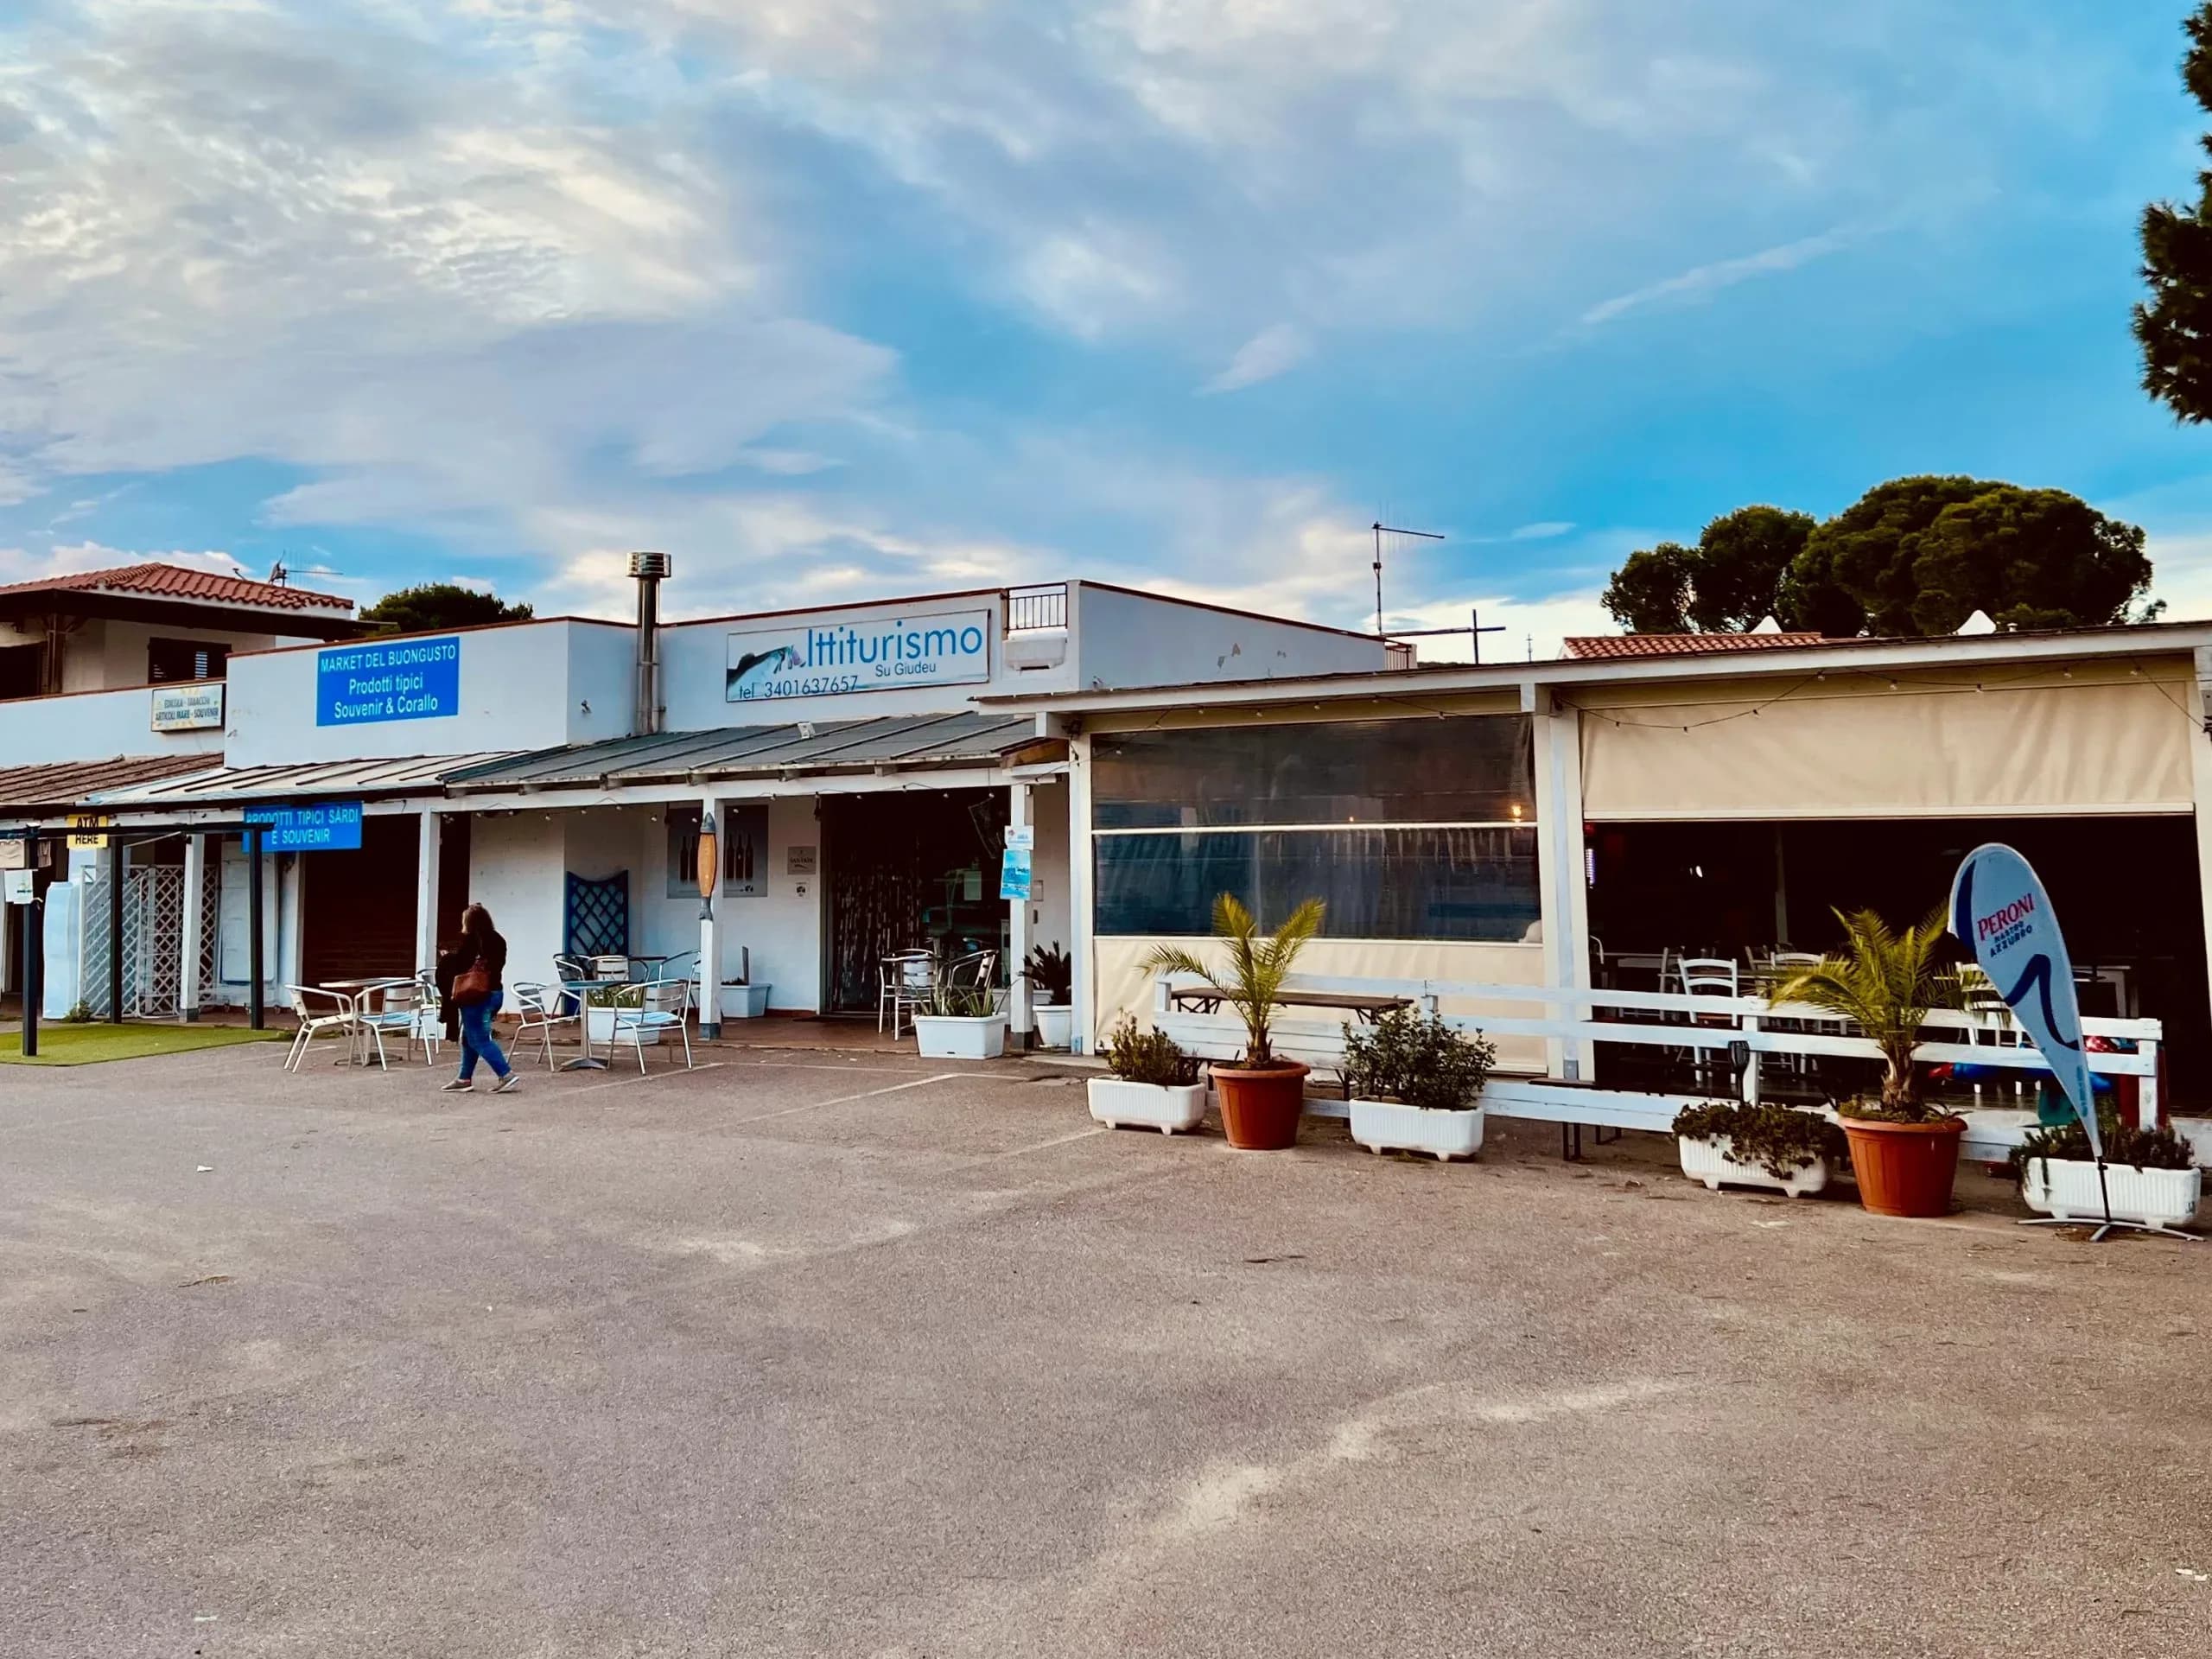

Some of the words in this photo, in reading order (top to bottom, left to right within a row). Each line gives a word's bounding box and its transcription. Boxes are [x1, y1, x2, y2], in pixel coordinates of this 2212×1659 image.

[808, 620, 982, 666] Ittiturismo
[321, 654, 363, 672] MARKET
[365, 652, 385, 668] DEL
[389, 645, 456, 664] BUONGUSTO
[875, 664, 891, 677] Su
[894, 662, 937, 676] Giudeu
[349, 675, 392, 695] Prodotti
[396, 671, 423, 694] tipici
[739, 683, 754, 699] tel
[764, 675, 858, 698] 3401637657
[334, 698, 384, 718] Souvenir
[385, 696, 394, 714] &
[397, 694, 438, 713] Corallo
[76, 817, 99, 829] ATM
[297, 810, 324, 825] TIPICI
[328, 809, 359, 823] SARDI
[75, 834, 99, 844] HERE
[271, 830, 278, 844] E
[282, 829, 330, 843] SOUVENIR
[1977, 893, 2035, 941] PERONI
[1990, 925, 2032, 957] AZZURRO
